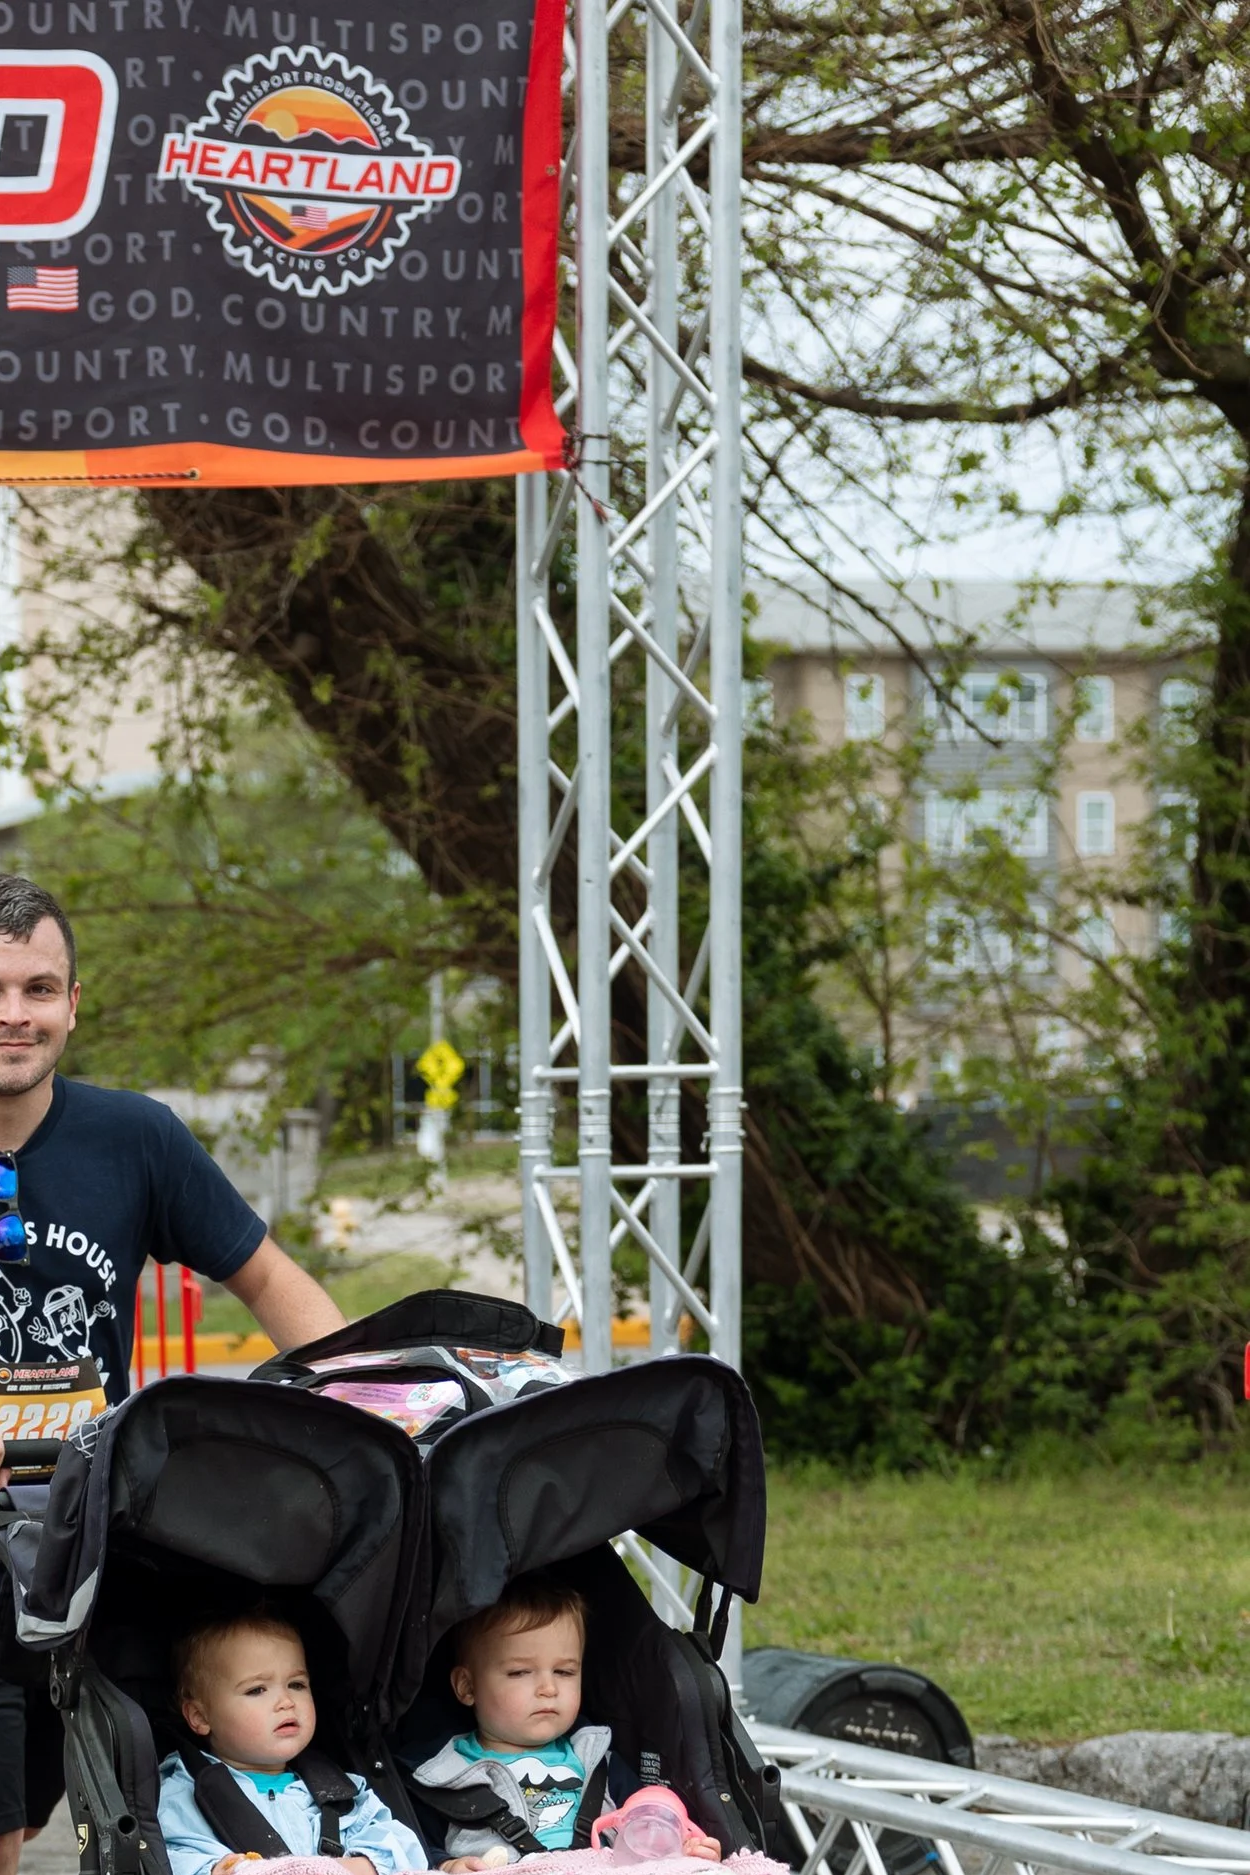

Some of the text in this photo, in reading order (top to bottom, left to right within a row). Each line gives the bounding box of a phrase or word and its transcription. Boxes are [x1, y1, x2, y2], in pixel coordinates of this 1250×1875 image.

[223, 71, 299, 133] MULTISPORT
[303, 71, 394, 148] PRODUCTIONS
[163, 138, 456, 195] HEARTLAND
[252, 235, 326, 272] RACING
[88, 287, 200, 322] GOD,
[221, 291, 468, 342] COUNTRY,
[225, 406, 334, 450] GOD,
[46, 1223, 116, 1292] HOUSE
[13, 1365, 80, 1379] HEARTLAND
